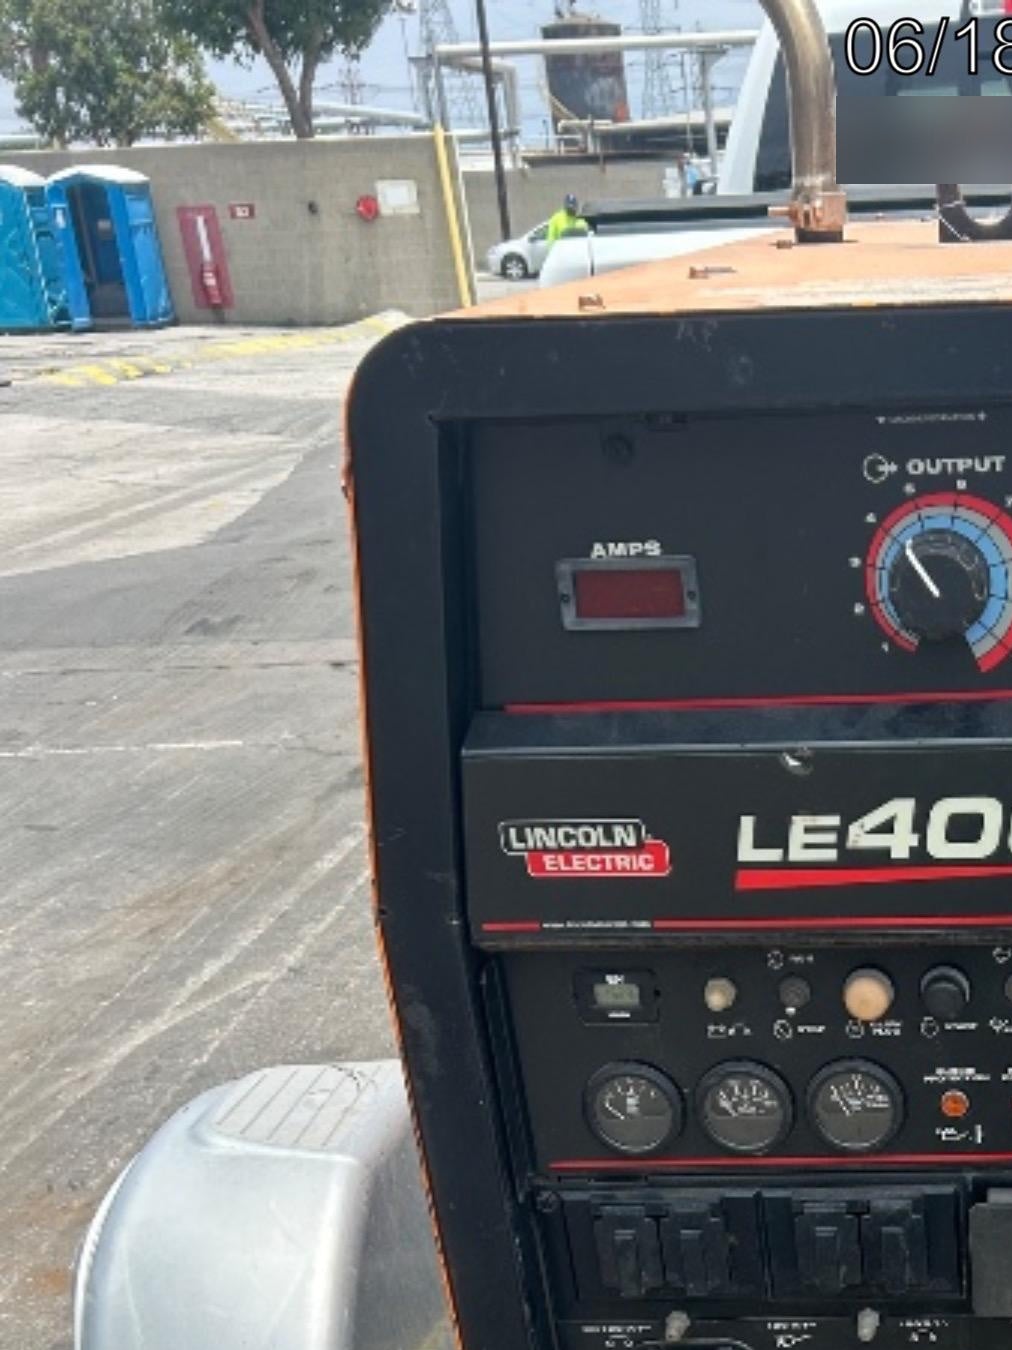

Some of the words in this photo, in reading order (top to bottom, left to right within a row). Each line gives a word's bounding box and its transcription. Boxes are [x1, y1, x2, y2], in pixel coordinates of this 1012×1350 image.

[905, 456, 1006, 475] OUTPUT
[590, 540, 662, 559] AMPS
[508, 823, 638, 850] LINCOLN
[542, 853, 655, 872] ELECTRIC
